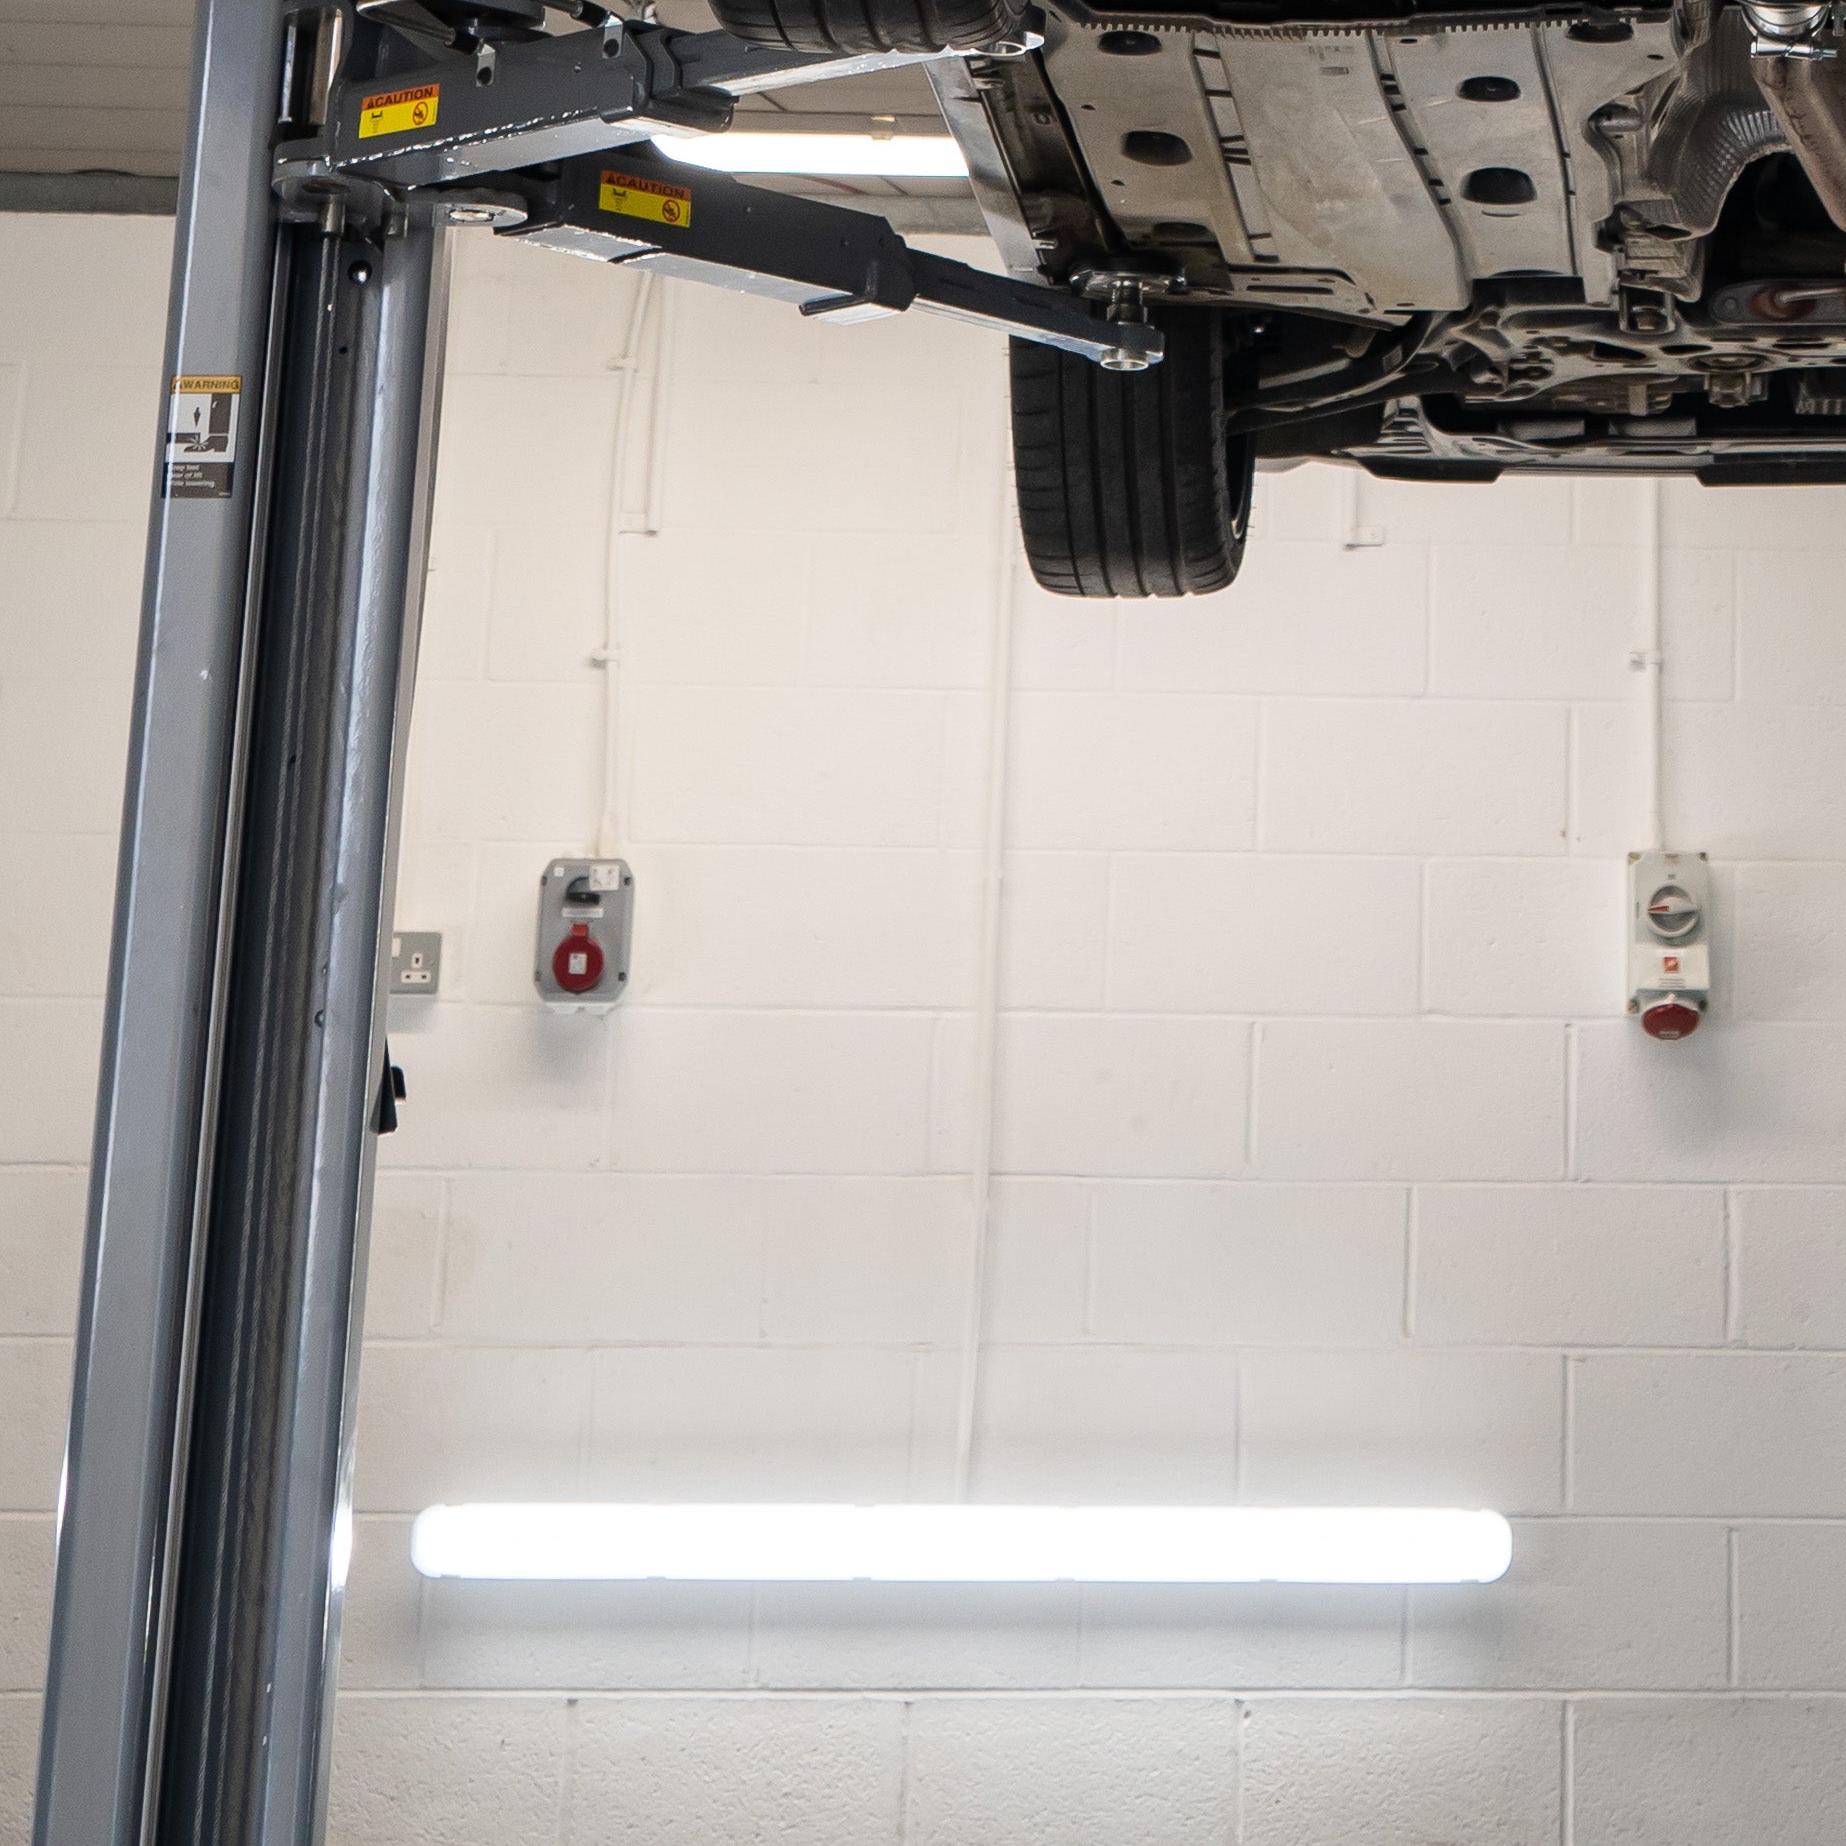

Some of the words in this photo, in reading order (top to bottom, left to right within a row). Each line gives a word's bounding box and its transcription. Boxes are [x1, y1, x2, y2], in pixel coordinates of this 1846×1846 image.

[375, 87, 433, 107] CAUTION
[617, 176, 684, 198] CAUTION
[184, 379, 239, 390] WARNING
